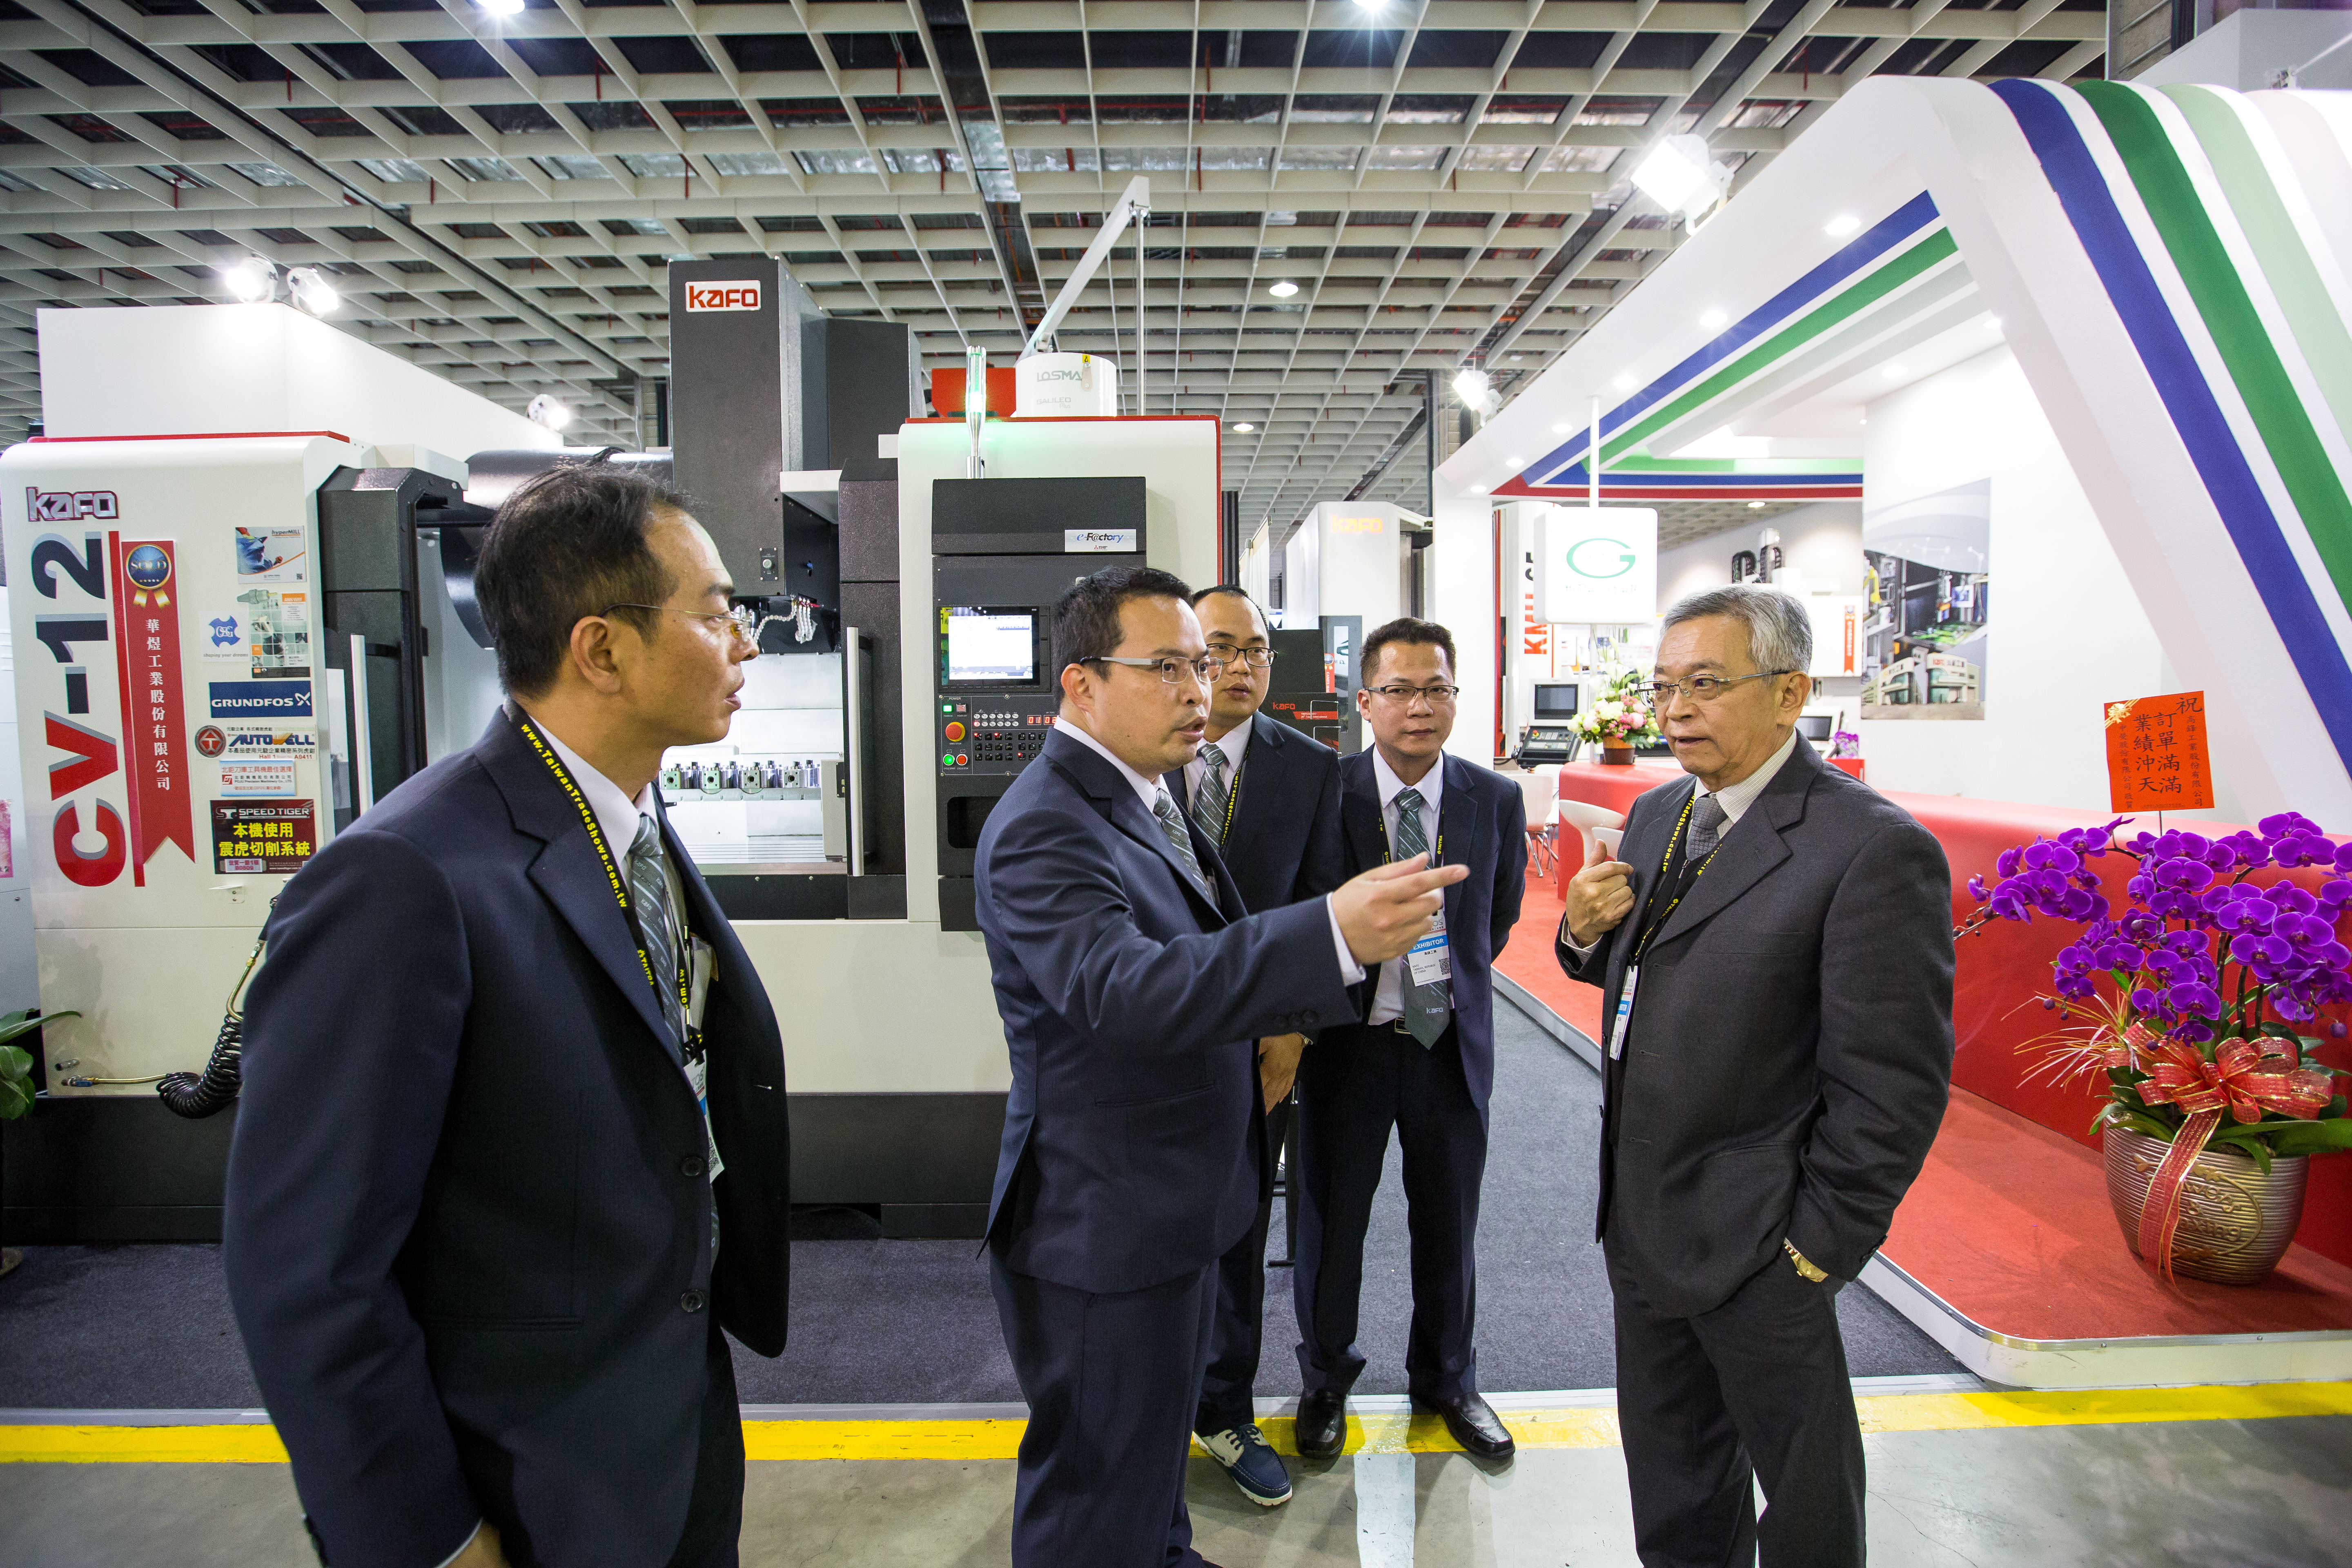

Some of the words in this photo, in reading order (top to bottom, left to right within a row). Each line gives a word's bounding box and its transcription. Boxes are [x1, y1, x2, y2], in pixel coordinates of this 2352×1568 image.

[1037, 370, 1082, 382] LOSMA
[130, 560, 167, 571] SOLD
[31, 531, 127, 887] CV-12
[145, 618, 170, 791] 華煜工業股份有限公司
[212, 698, 294, 707] GRUNDFOS
[2176, 697, 2203, 714] 祝
[2133, 713, 2158, 793] 業績沖天
[2153, 712, 2182, 794] 訂單滿滿
[521, 724, 628, 908] www.TaiwanTradeShows.com.tw
[232, 822, 294, 838] 本機使用
[218, 841, 311, 857] 震虎切削系統
[1413, 938, 1445, 950] EXHIBITOR
[641, 956, 654, 986] TAITRA
